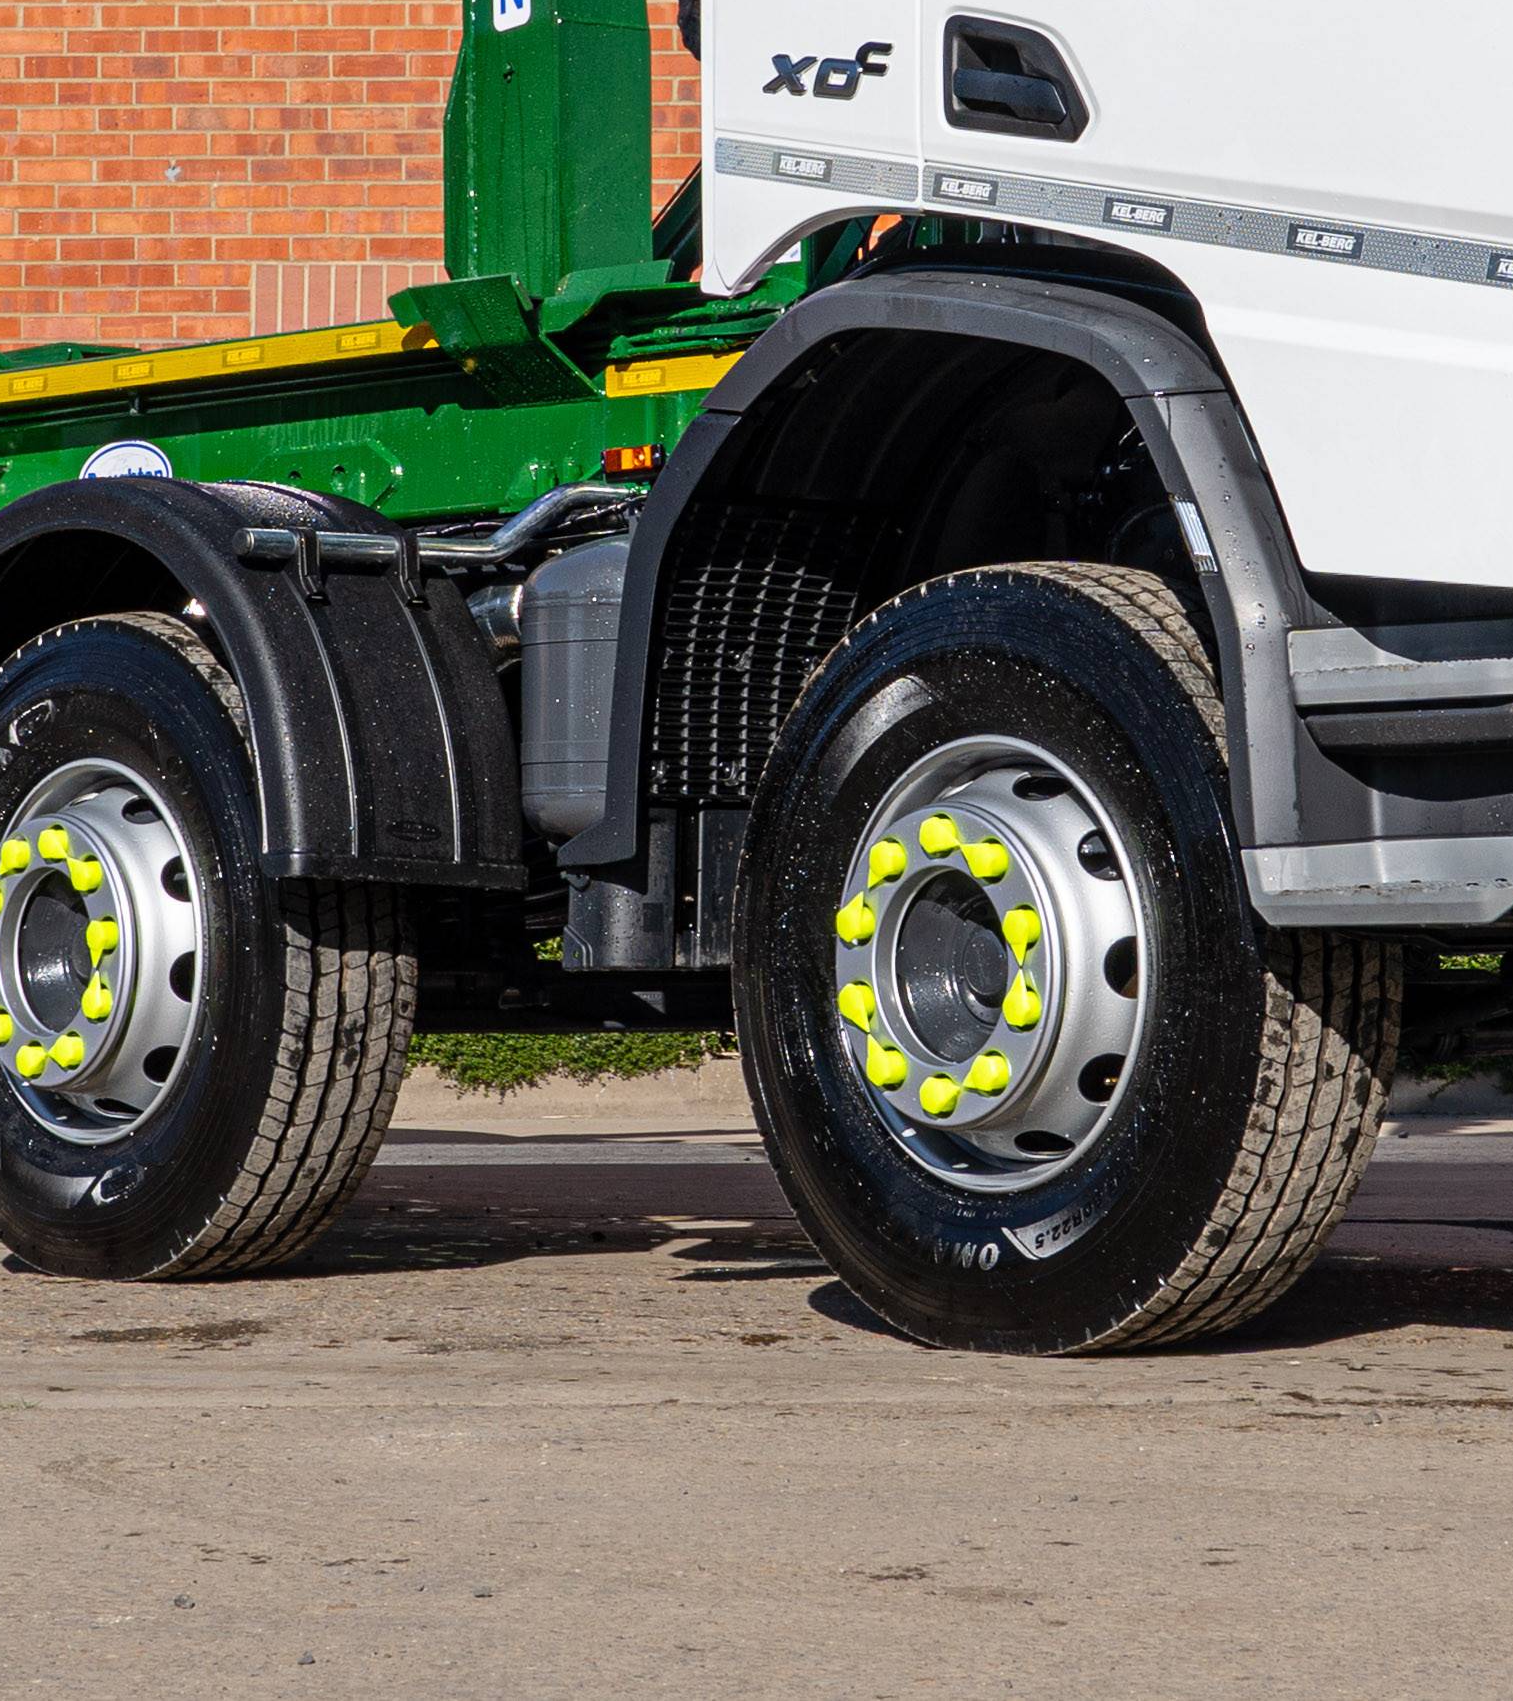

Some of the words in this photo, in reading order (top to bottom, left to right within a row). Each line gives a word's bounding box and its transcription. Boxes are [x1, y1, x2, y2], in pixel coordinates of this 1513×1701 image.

[780, 155, 827, 176] KEL-BERG
[941, 178, 993, 200] KEL-BERG
[1111, 201, 1167, 224] KEL-BERG
[1295, 228, 1356, 252] KEL-BERG
